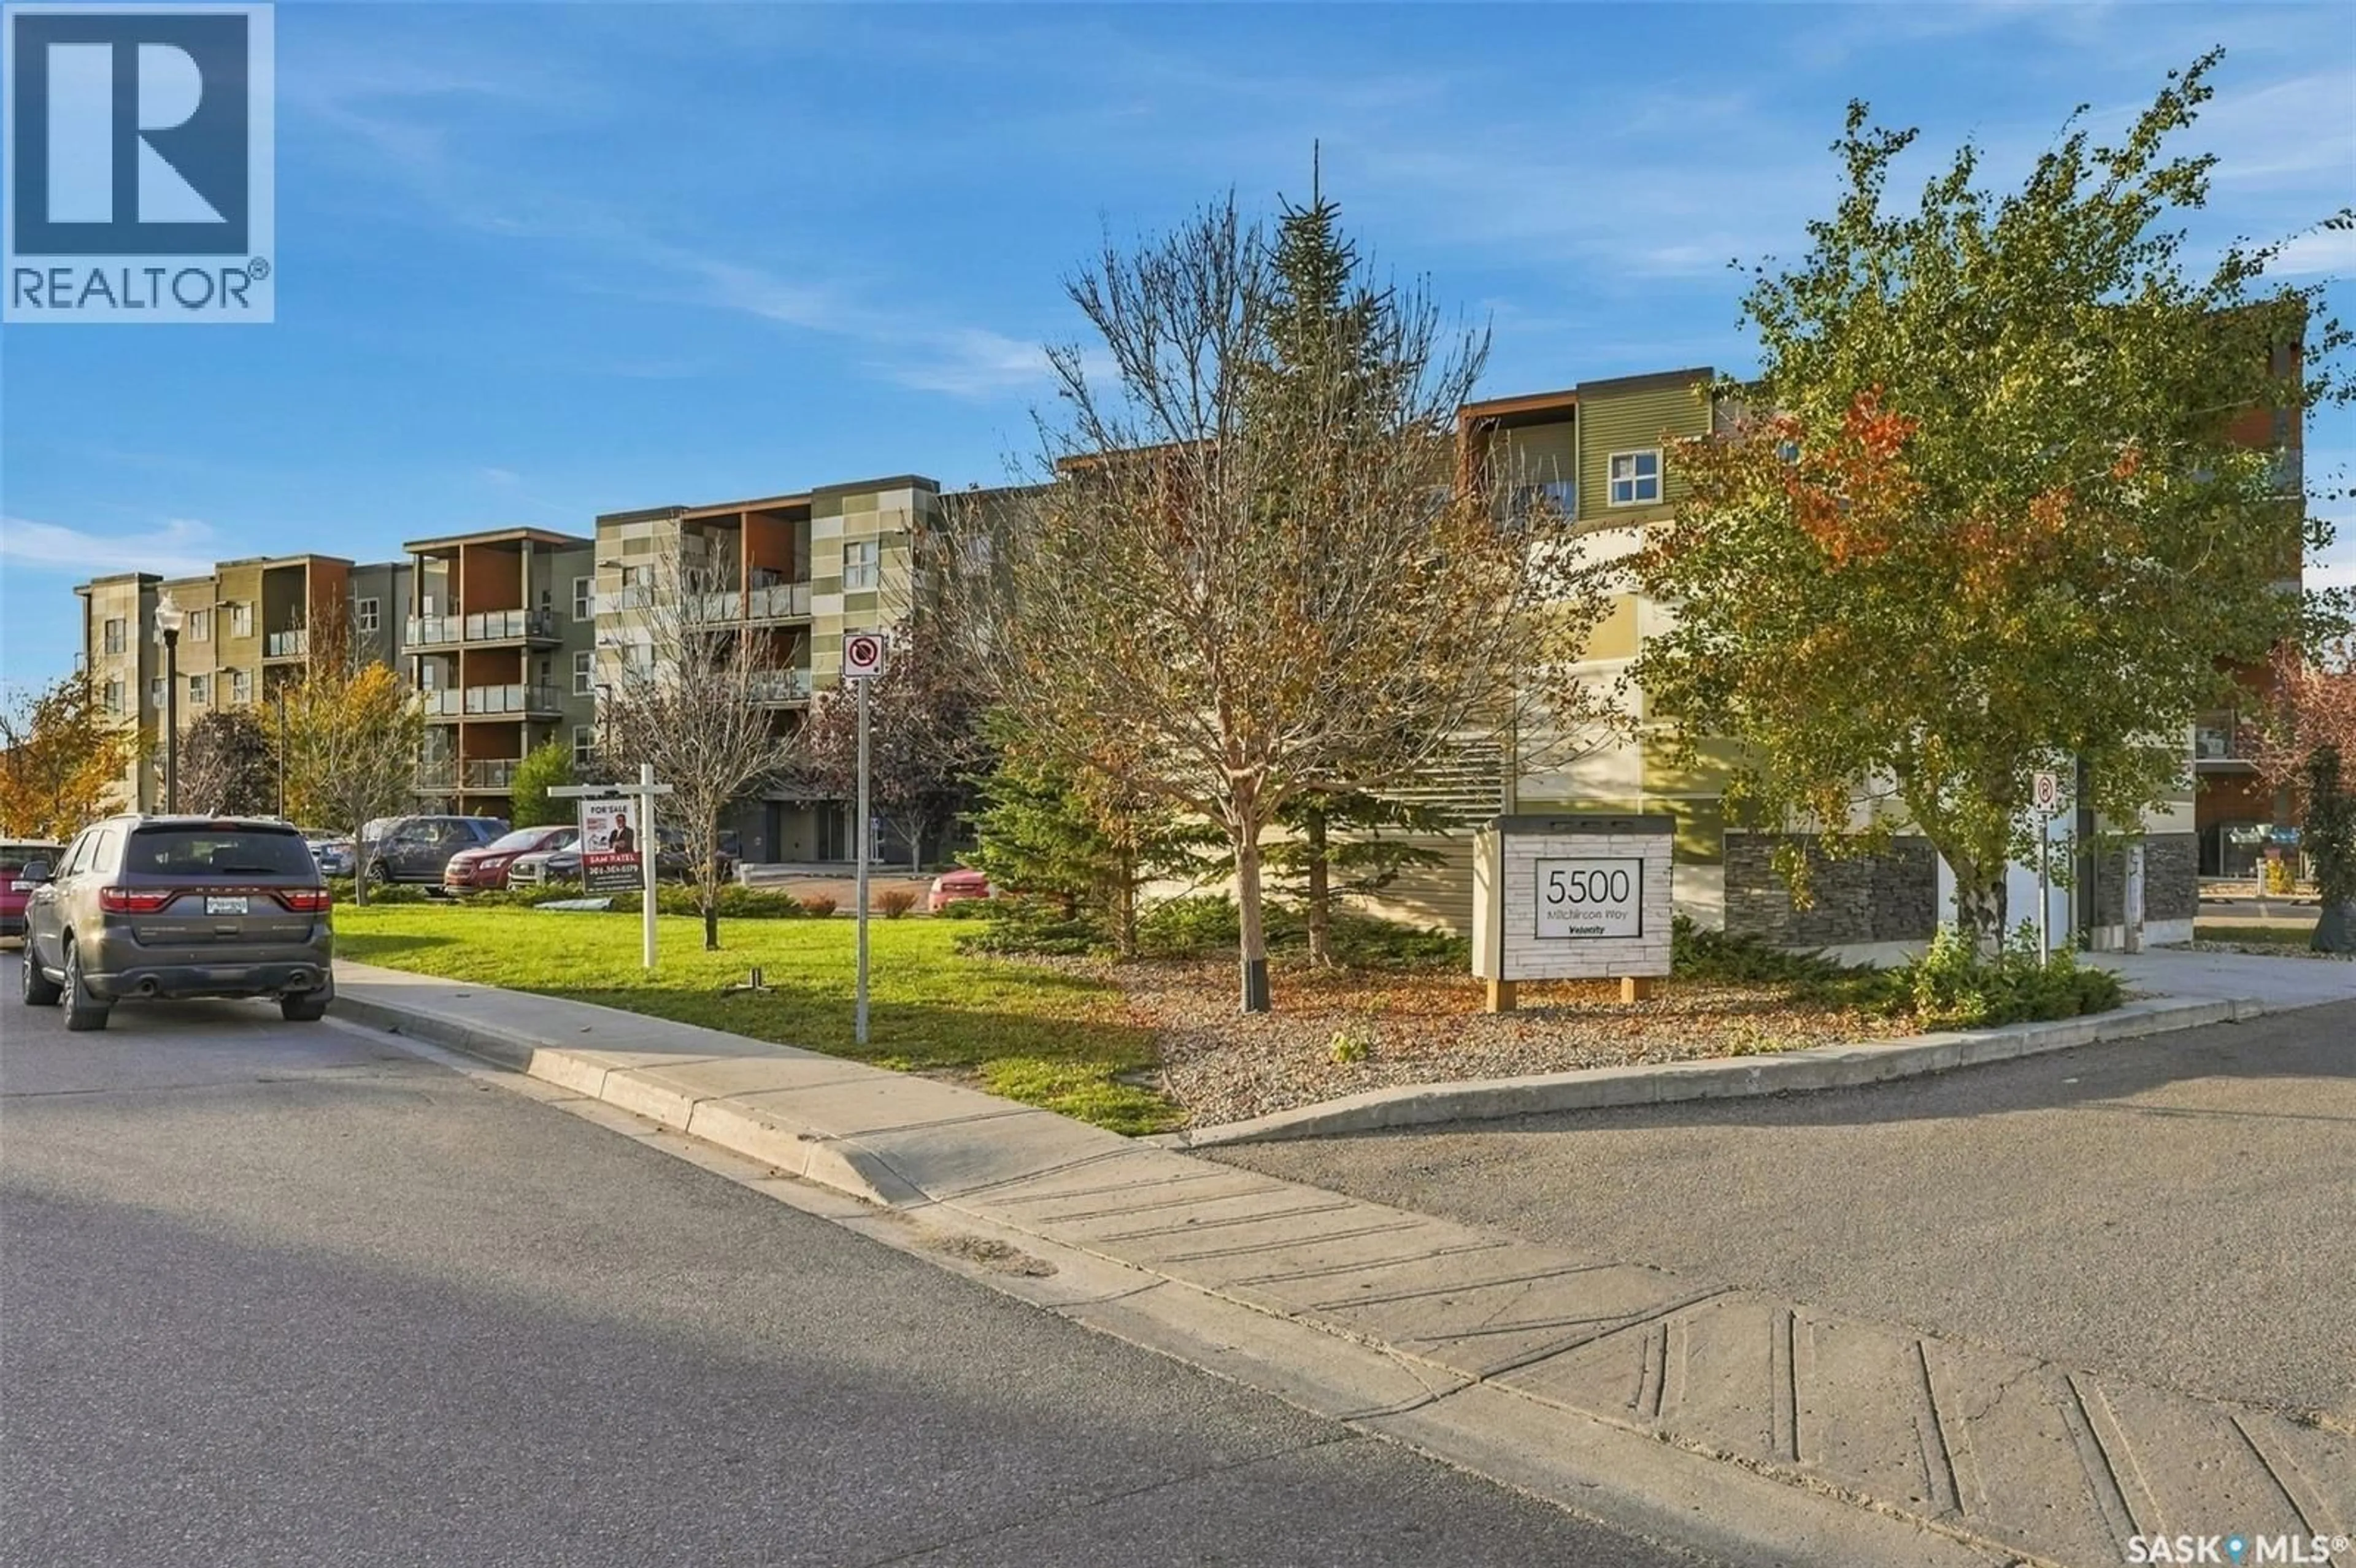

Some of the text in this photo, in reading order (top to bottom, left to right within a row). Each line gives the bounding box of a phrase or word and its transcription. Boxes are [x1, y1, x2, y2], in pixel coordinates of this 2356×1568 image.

[609, 804, 628, 813] SALE
[1546, 869, 1630, 904] 5500
[1605, 909, 1628, 920] Way
